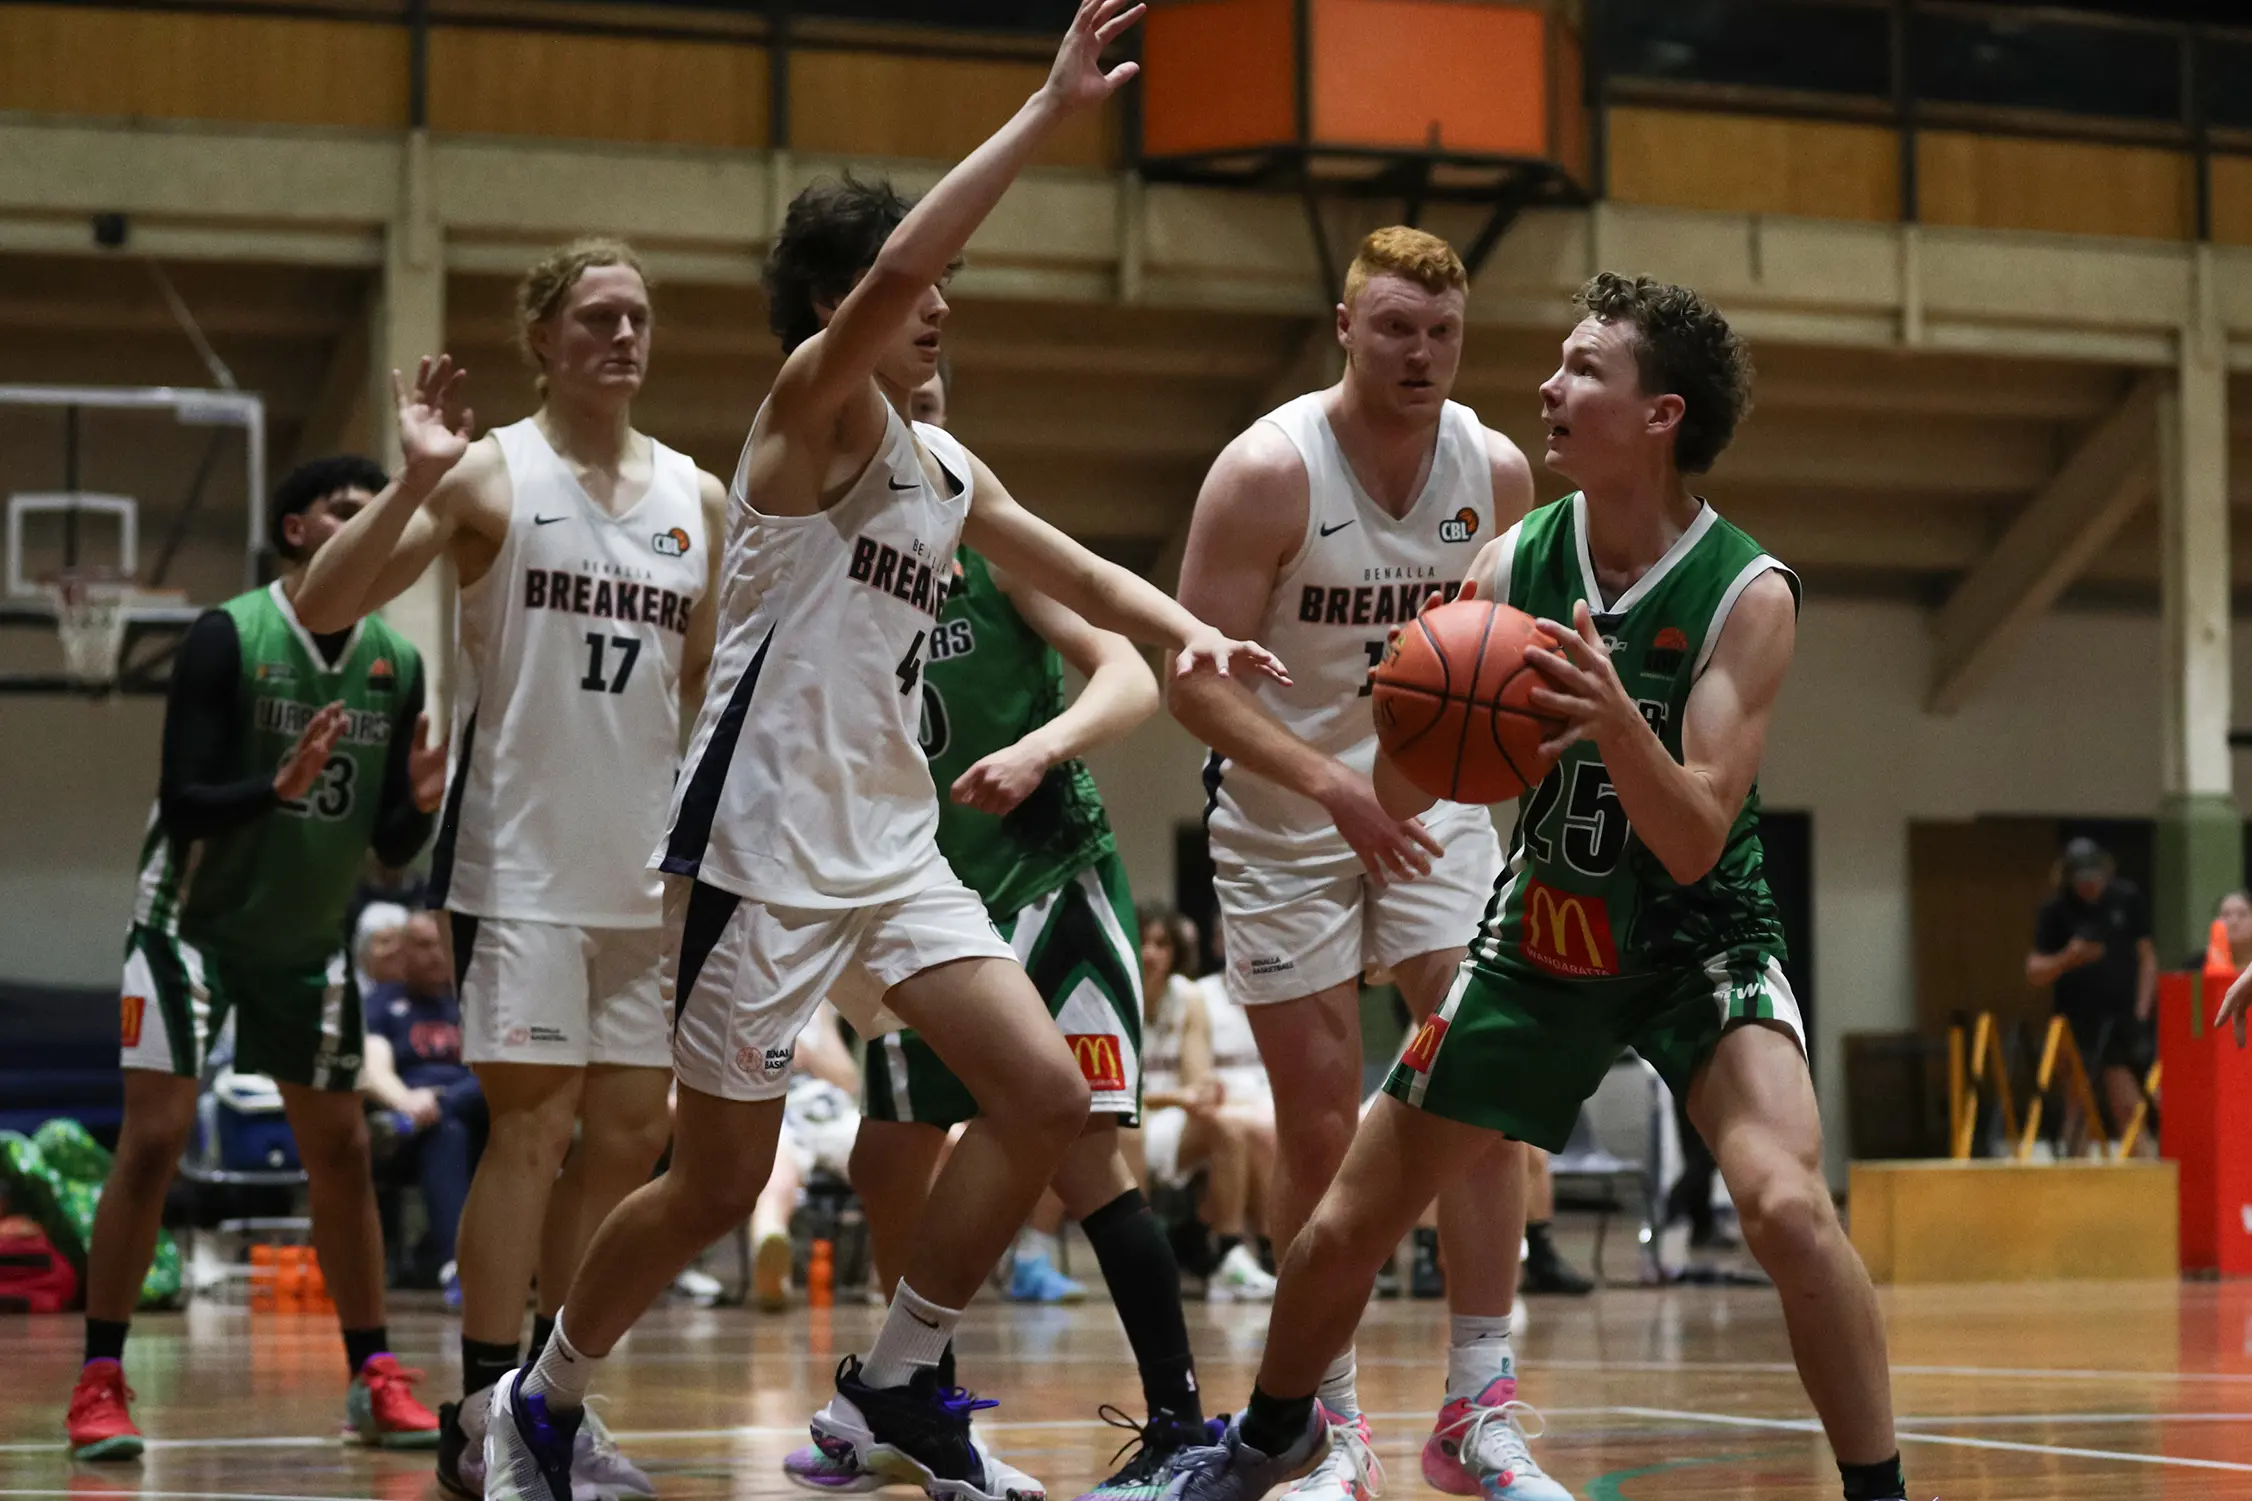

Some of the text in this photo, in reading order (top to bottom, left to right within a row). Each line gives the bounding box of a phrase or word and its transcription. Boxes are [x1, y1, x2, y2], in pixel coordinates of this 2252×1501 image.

[1441, 522, 1470, 541] CBL
[525, 568, 694, 636] BREAKERS
[1364, 566, 1436, 582] BENALLA
[579, 632, 641, 694] 17
[896, 630, 926, 696] 4
[1522, 759, 1631, 877] 25
